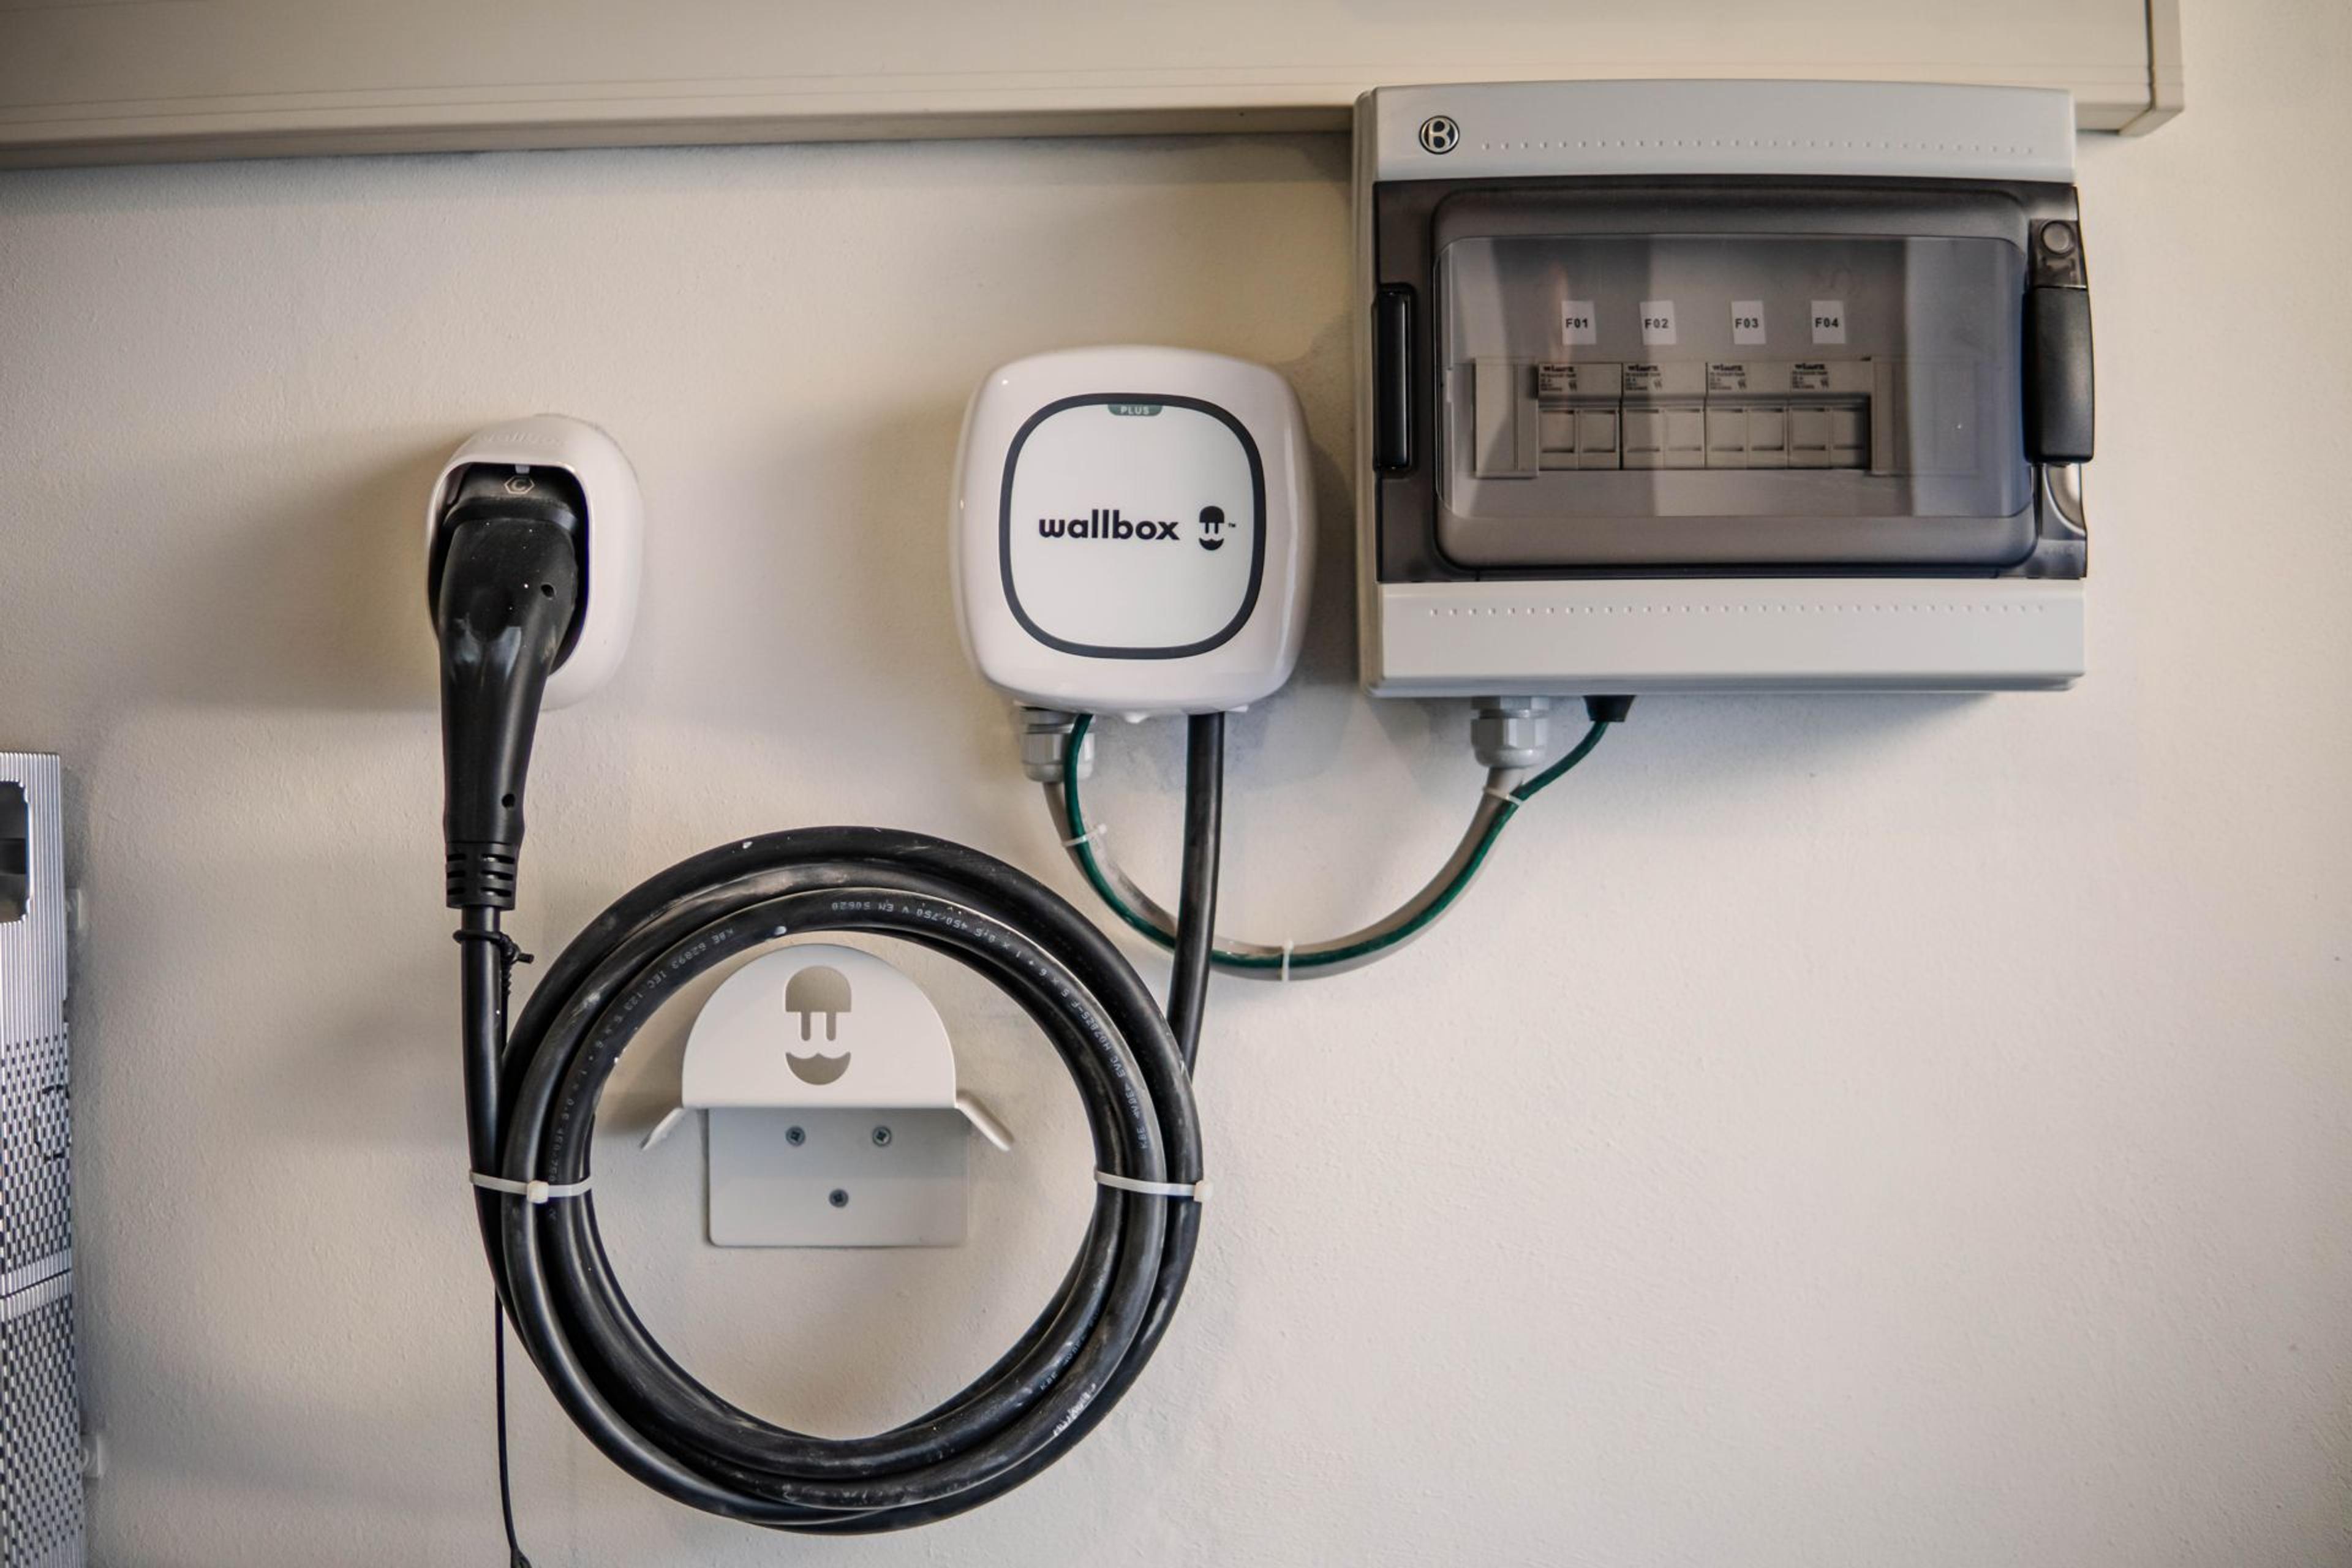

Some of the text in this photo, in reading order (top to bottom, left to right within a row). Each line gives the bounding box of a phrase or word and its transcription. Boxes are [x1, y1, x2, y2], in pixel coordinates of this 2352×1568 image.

[1566, 318, 1588, 328] F01
[1645, 318, 1668, 329] F02
[1735, 318, 1758, 328] F03
[1815, 317, 1839, 328] F04
[1120, 406, 1150, 415] PLUS
[1038, 509, 1180, 540] wallbox
[879, 903, 893, 911] EN
[1039, 968, 1047, 976] 6
[647, 971, 666, 987] IEC
[1061, 989, 1069, 997] 5
[1110, 1055, 1125, 1077] EVC
[1137, 1126, 1147, 1148] KBE
